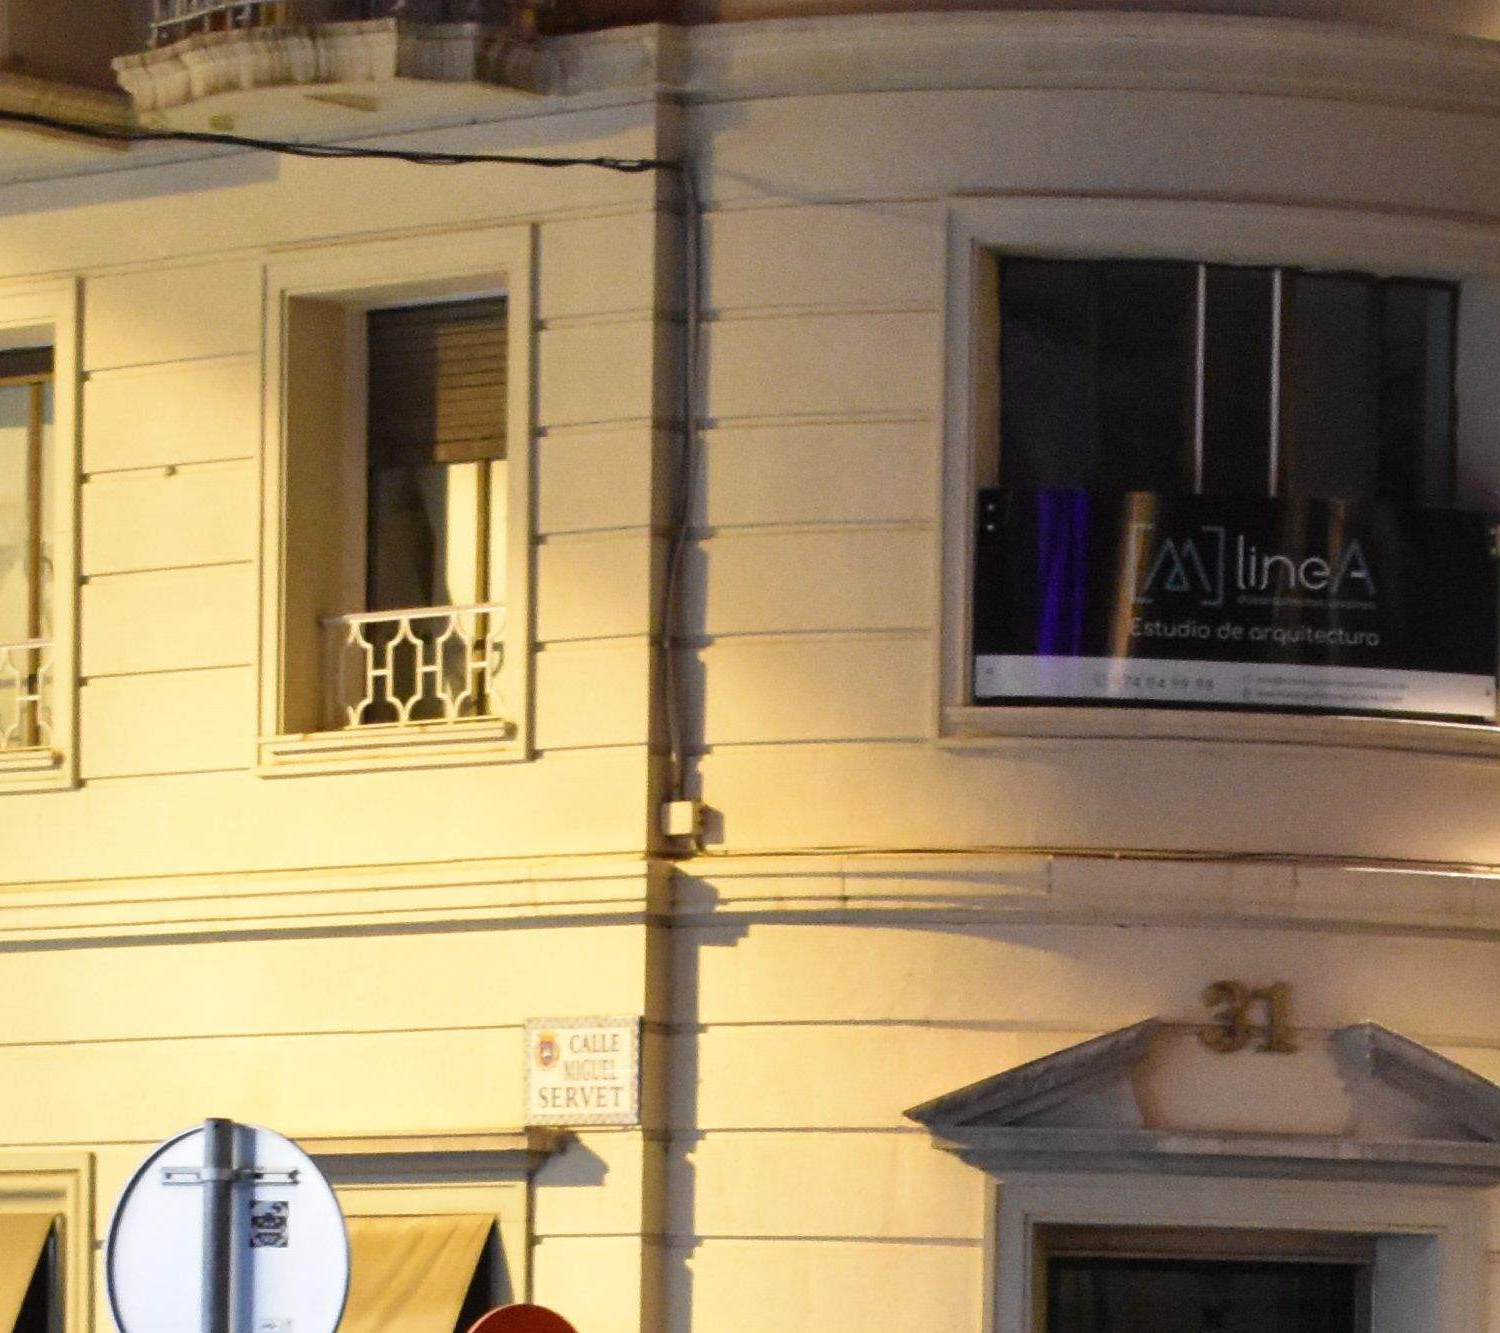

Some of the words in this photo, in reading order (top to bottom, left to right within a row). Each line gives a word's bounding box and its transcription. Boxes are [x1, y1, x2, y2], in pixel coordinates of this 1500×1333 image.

[1236, 533, 1377, 596] lineA
[1217, 621, 1244, 641] de
[1250, 624, 1380, 647] arquitectura
[1199, 979, 1299, 1055] 31
[569, 1033, 621, 1054] CALLE
[564, 1059, 618, 1081] MIGUEL
[538, 1086, 625, 1109] SERVET
